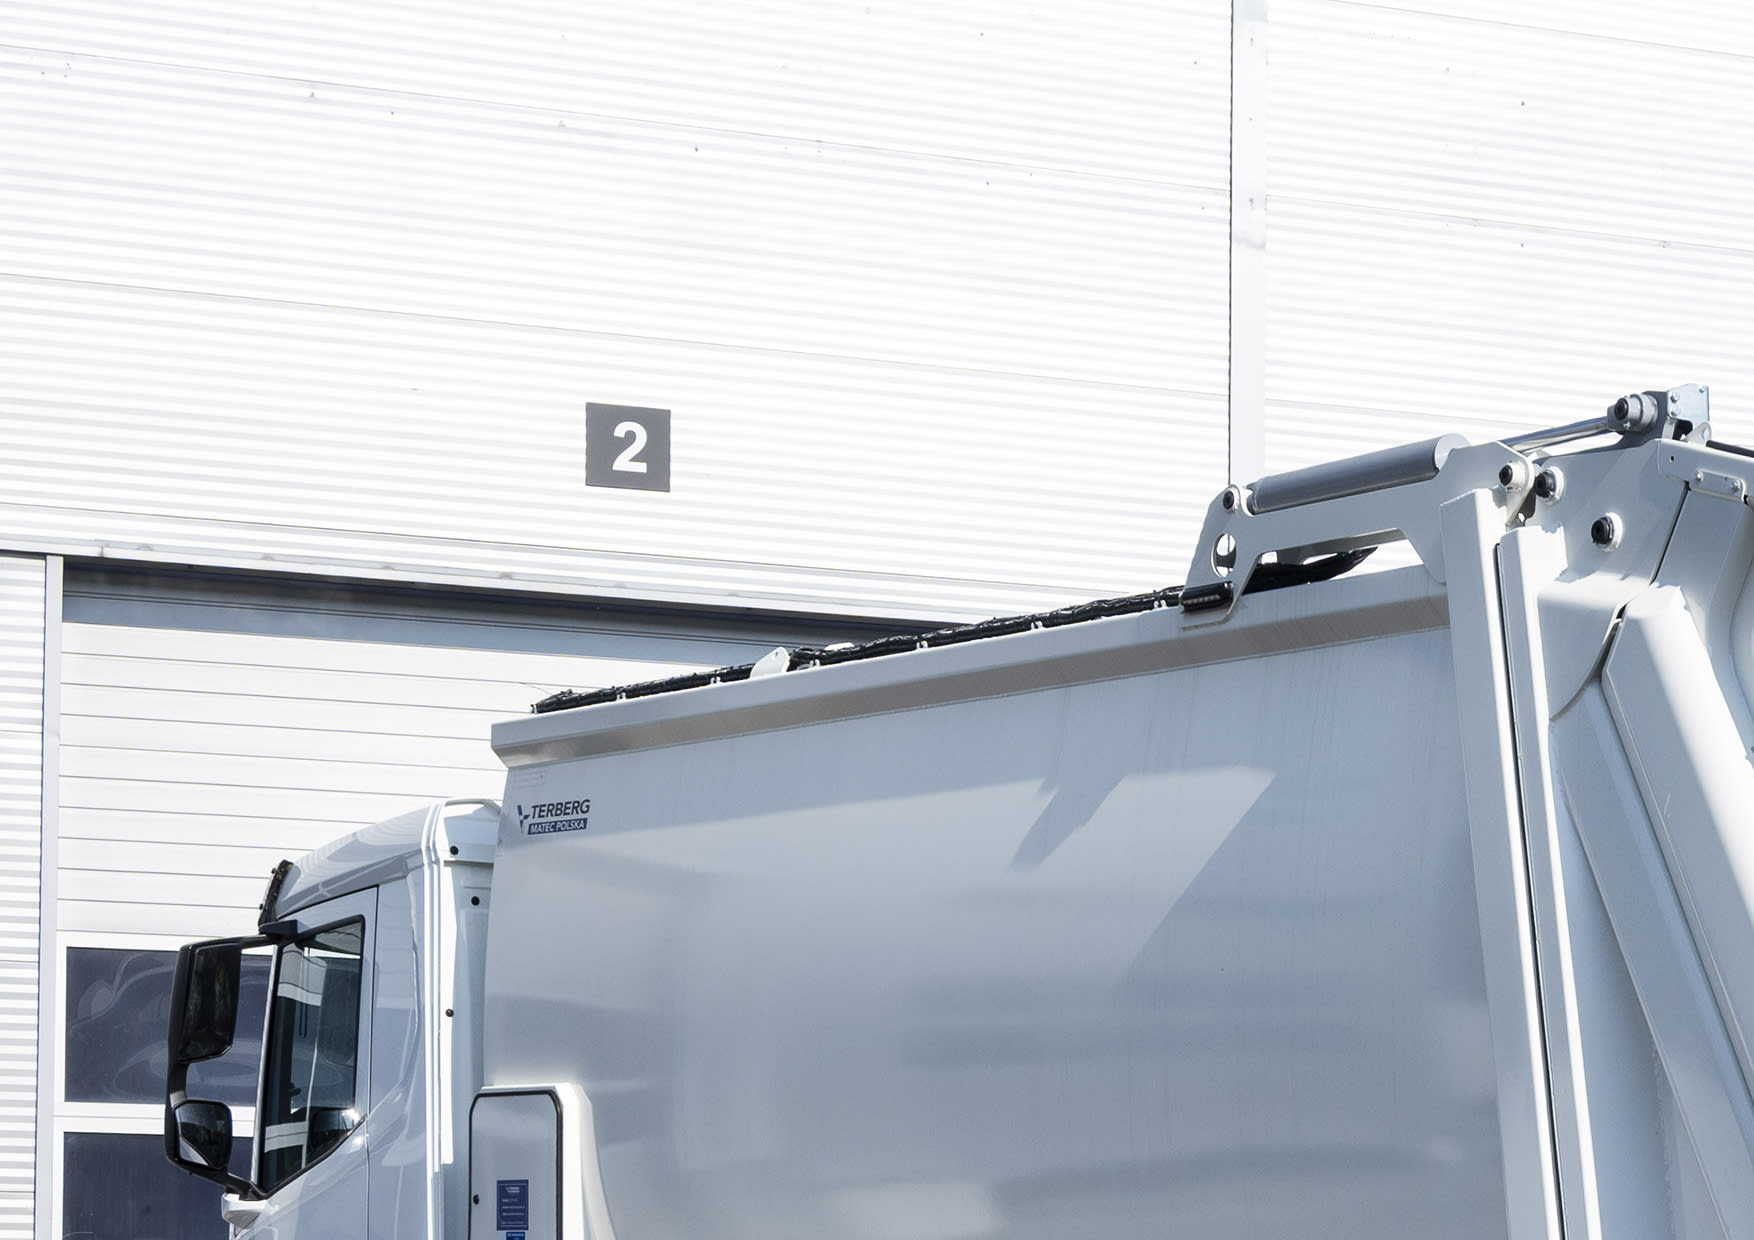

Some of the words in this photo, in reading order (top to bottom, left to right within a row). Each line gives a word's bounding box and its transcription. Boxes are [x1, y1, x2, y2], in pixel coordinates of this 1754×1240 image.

[612, 421, 647, 473] 2
[531, 799, 591, 819] TERBERG
[530, 822, 555, 834] MATEC
[556, 819, 585, 831] POLSKA
